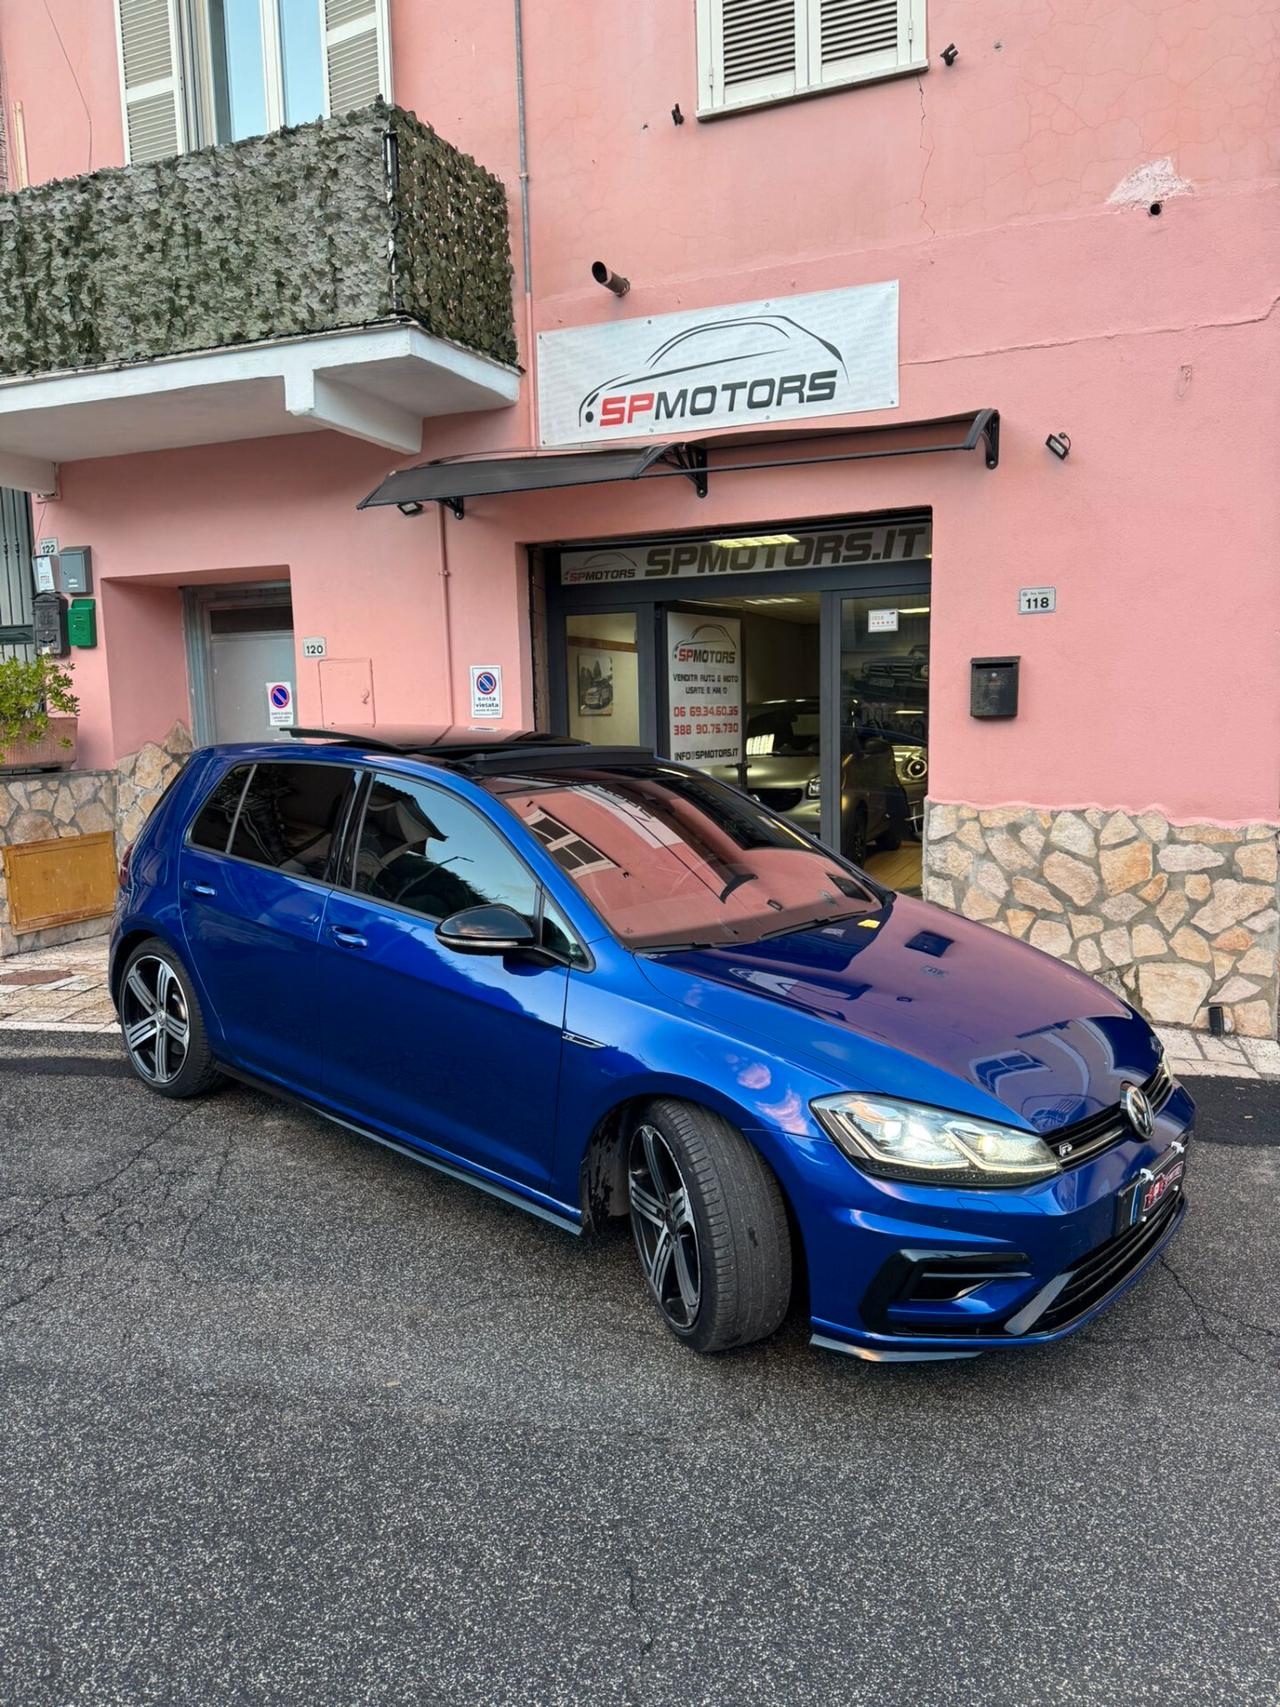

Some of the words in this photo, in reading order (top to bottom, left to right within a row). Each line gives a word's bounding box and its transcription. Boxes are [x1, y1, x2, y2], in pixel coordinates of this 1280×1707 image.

[600, 370, 838, 426] SPMOTORS
[42, 544, 56, 554] 122
[644, 527, 926, 577] SPMOTORS.IT
[569, 567, 636, 582] SPMOTORS
[1026, 597, 1049, 609] 118
[306, 645, 324, 654] 120
[678, 648, 736, 664] SPMOTORS
[674, 706, 686, 717] 06
[689, 706, 738, 716] 69.34.60.35
[674, 724, 691, 736] 388
[696, 723, 739, 734] 90.75.730
